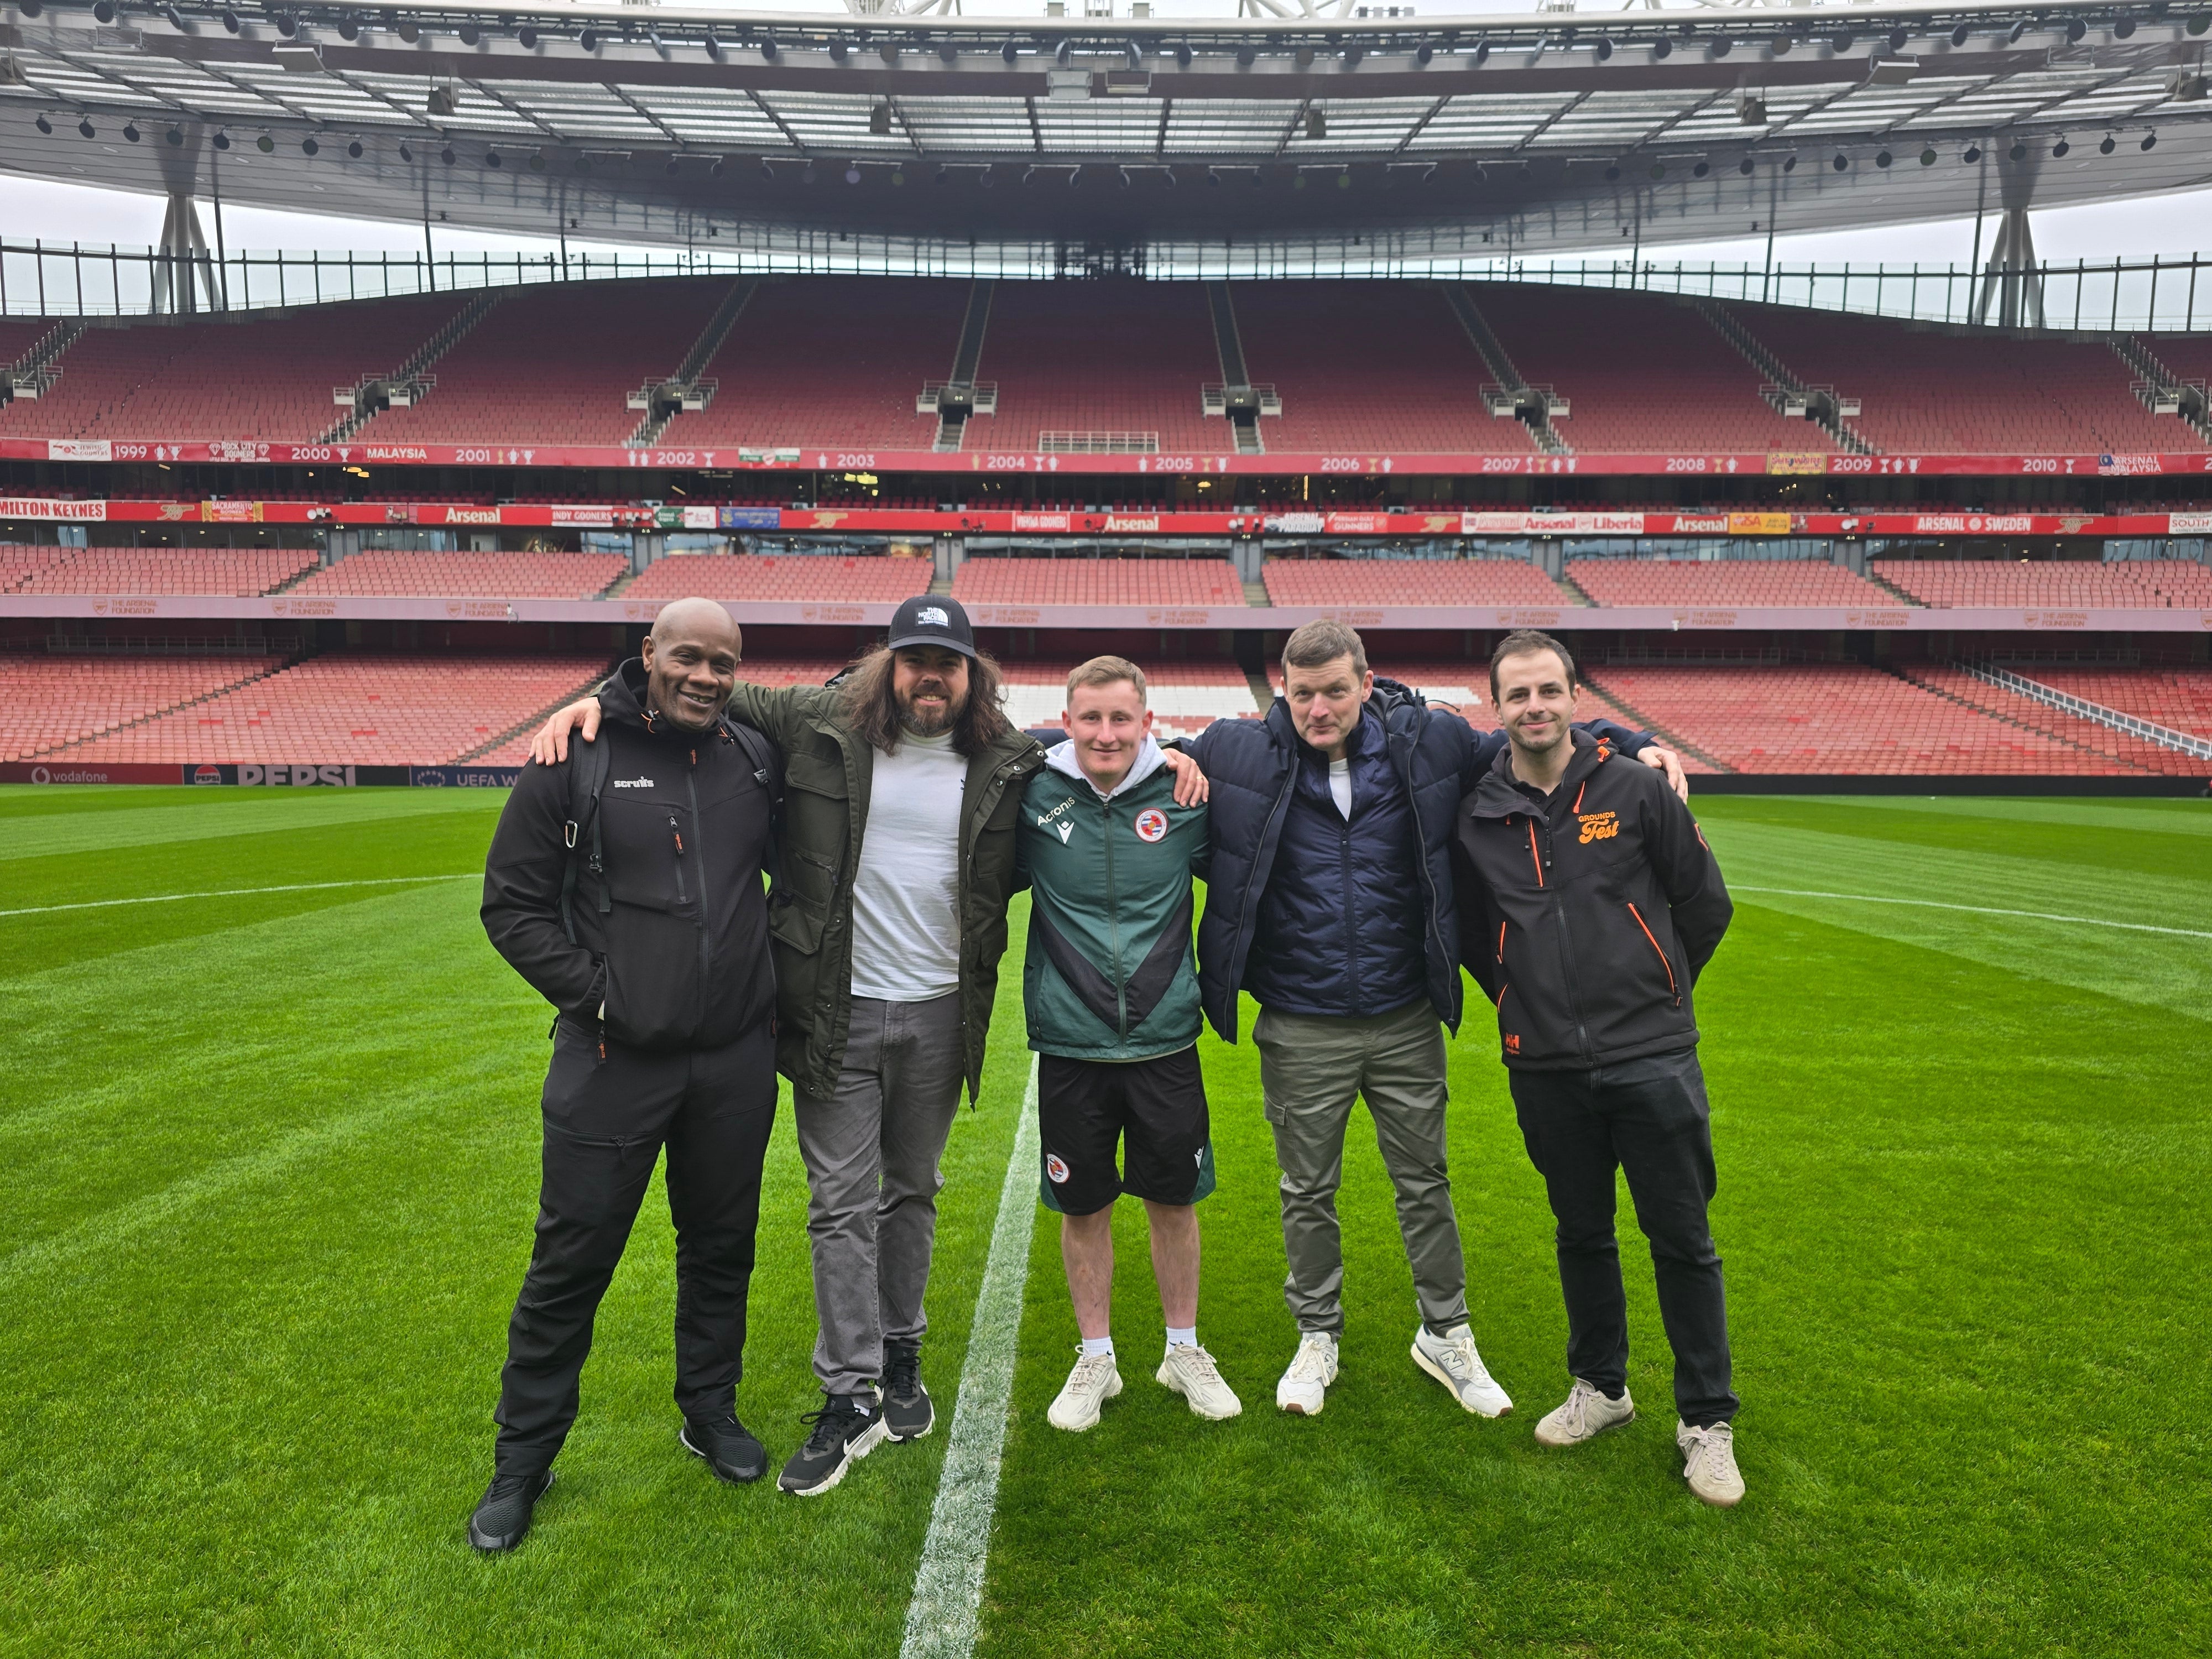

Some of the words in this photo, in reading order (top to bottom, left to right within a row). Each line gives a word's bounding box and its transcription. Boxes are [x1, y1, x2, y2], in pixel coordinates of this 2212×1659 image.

[115, 445, 147, 458] 1999
[291, 447, 330, 460] 2000
[367, 448, 427, 459] MALAYSIA
[456, 449, 490, 462] 2001
[658, 452, 695, 465] 2002
[837, 454, 875, 467] 2003
[988, 456, 1025, 468] 2004
[1156, 457, 1193, 470] 2005
[1322, 458, 1360, 470] 2006
[1483, 458, 1520, 471] 2007
[1667, 458, 1705, 471] 2008
[1833, 458, 1872, 471] 2009
[2113, 456, 2159, 466] ARSENAL
[2023, 459, 2057, 472] 2010
[2110, 463, 2162, 474] MALAYSIA
[0, 501, 50, 516] MILTON
[53, 503, 103, 518] KEYNES
[211, 502, 253, 510] SACRAMENTO
[446, 507, 500, 523] Arsenal
[553, 510, 572, 520] INDY
[573, 510, 612, 520] GOONERS
[1016, 515, 1039, 528] VIENNA
[1040, 515, 1066, 528] GOONERS
[1284, 512, 1319, 521] ARSENAL
[1105, 515, 1159, 531] Arsenal
[1279, 522, 1324, 533] PARAGUAY
[1333, 522, 1374, 531] GUNNERS
[1525, 517, 1576, 529] Arsenal
[1593, 517, 1637, 529] Liberia
[1673, 517, 1728, 531] Arsenal
[1917, 517, 1964, 530] ARSENAL
[1986, 518, 2031, 530] SWEDEN
[2172, 519, 2209, 528] SOUTH
[53, 771, 107, 782] vodafone
[237, 765, 356, 786] PEPSI
[457, 774, 497, 786] UEFA
[1037, 797, 1075, 826] Acronis
[1578, 811, 1616, 822] GROUNDS
[1579, 818, 1620, 844] Fest
